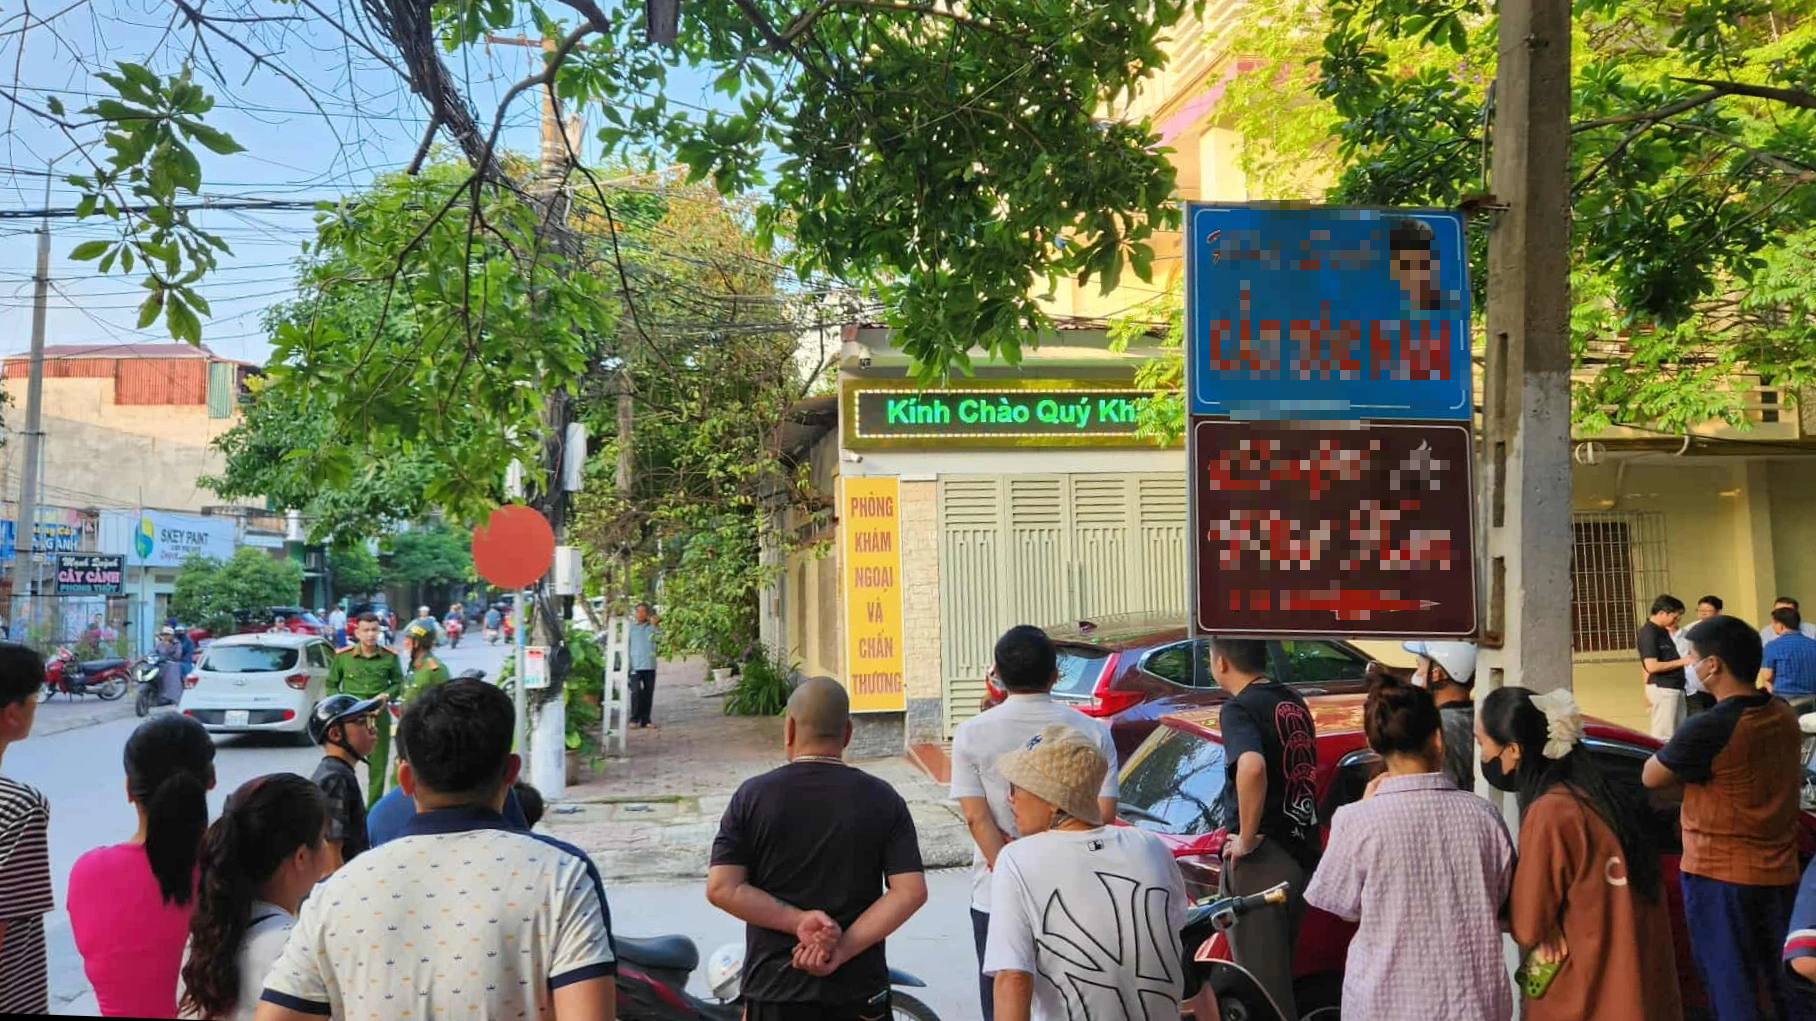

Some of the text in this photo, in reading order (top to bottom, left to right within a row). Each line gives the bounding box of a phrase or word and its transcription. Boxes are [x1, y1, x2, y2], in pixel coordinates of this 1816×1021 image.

[887, 397, 950, 424] Kính
[958, 397, 1030, 424] Chào
[1036, 397, 1091, 428] Quý
[851, 491, 894, 517] PHÒNG
[161, 529, 209, 545] SKEY PAINT
[855, 527, 891, 552] KHÁM
[58, 567, 120, 583] CÂY CẢNH
[855, 566, 893, 592] NGOẠI
[867, 596, 883, 623] VÀ
[859, 628, 893, 659] CHẤN
[852, 670, 902, 695] THƯƠNG
